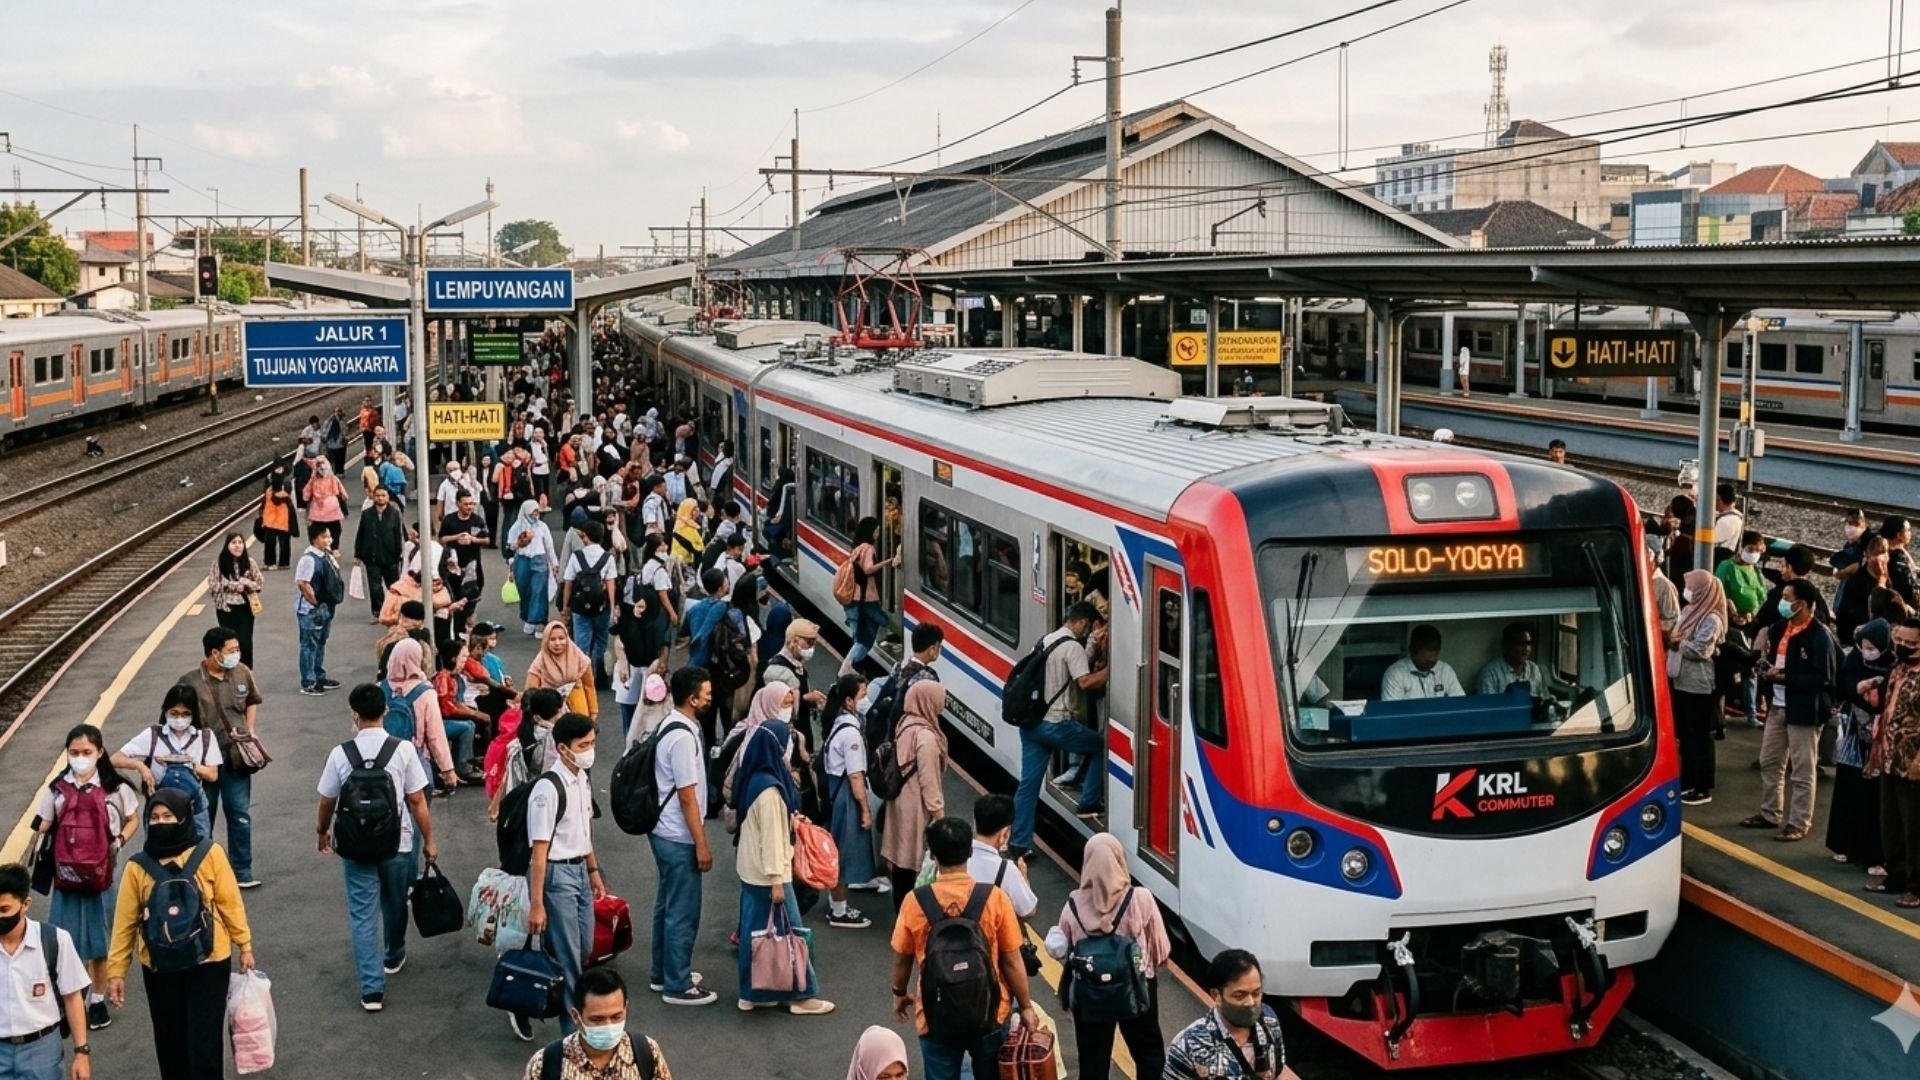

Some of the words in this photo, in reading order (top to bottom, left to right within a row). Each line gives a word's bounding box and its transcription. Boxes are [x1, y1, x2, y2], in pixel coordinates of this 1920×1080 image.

[435, 280, 565, 300] LEMPUYANGAN
[315, 326, 374, 342] JALUR
[379, 326, 387, 341] 1
[1586, 340, 1675, 364] HATI-HATI
[253, 357, 307, 376] TUJUAN
[310, 356, 399, 375] YOGYAKARTA
[433, 409, 500, 424] HATI-HATI
[1368, 544, 1524, 574] SOLO-YOGYA
[1478, 771, 1528, 797] KRL
[1478, 794, 1555, 812] COMMUTER
